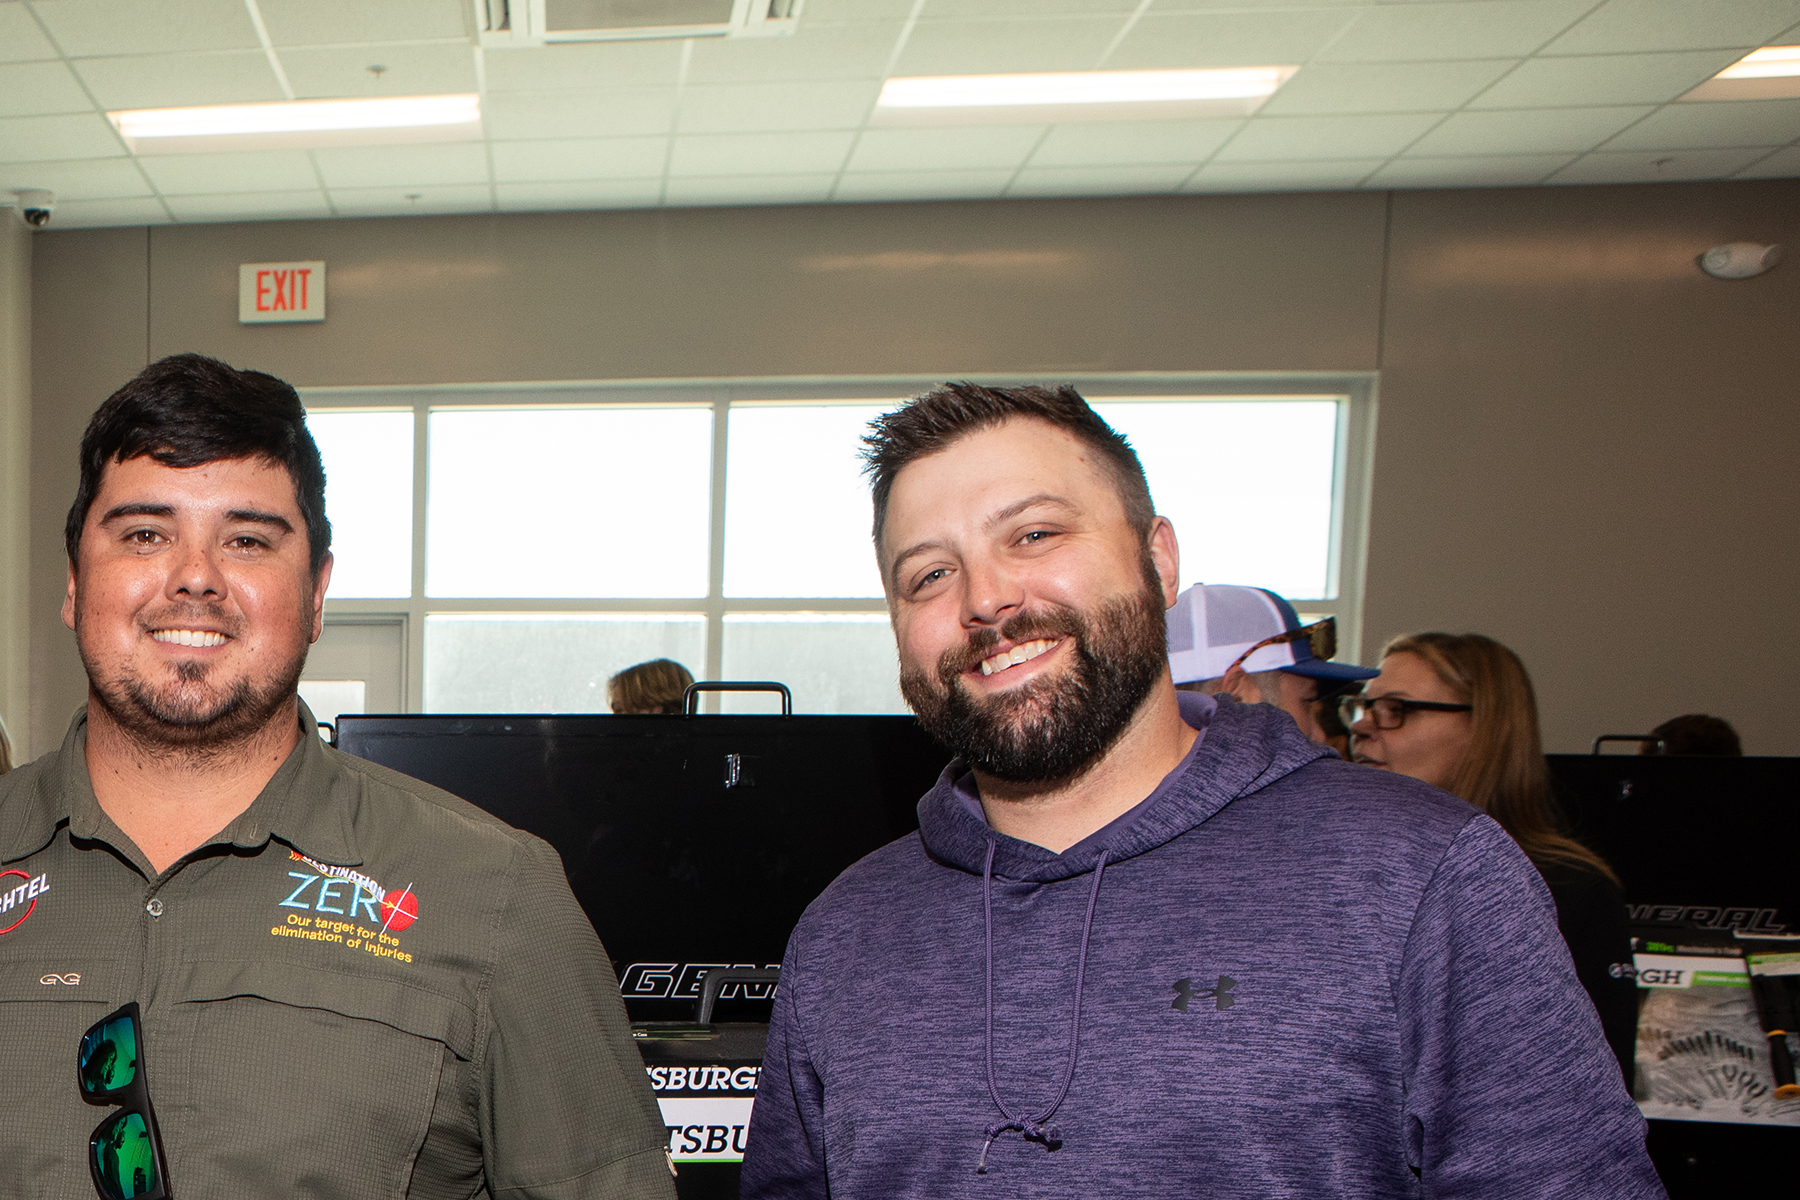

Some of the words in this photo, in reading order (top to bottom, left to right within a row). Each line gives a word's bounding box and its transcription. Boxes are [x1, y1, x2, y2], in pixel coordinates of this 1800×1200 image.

[256, 269, 311, 312] EXIT
[271, 925, 343, 944] elimination
[346, 938, 362, 949] of
[365, 940, 413, 963] injuries
[287, 914, 312, 927] Our
[315, 917, 356, 935] target
[356, 926, 377, 940] for
[379, 932, 400, 947] the
[619, 962, 781, 999] GEN
[646, 1066, 762, 1091] SBURG
